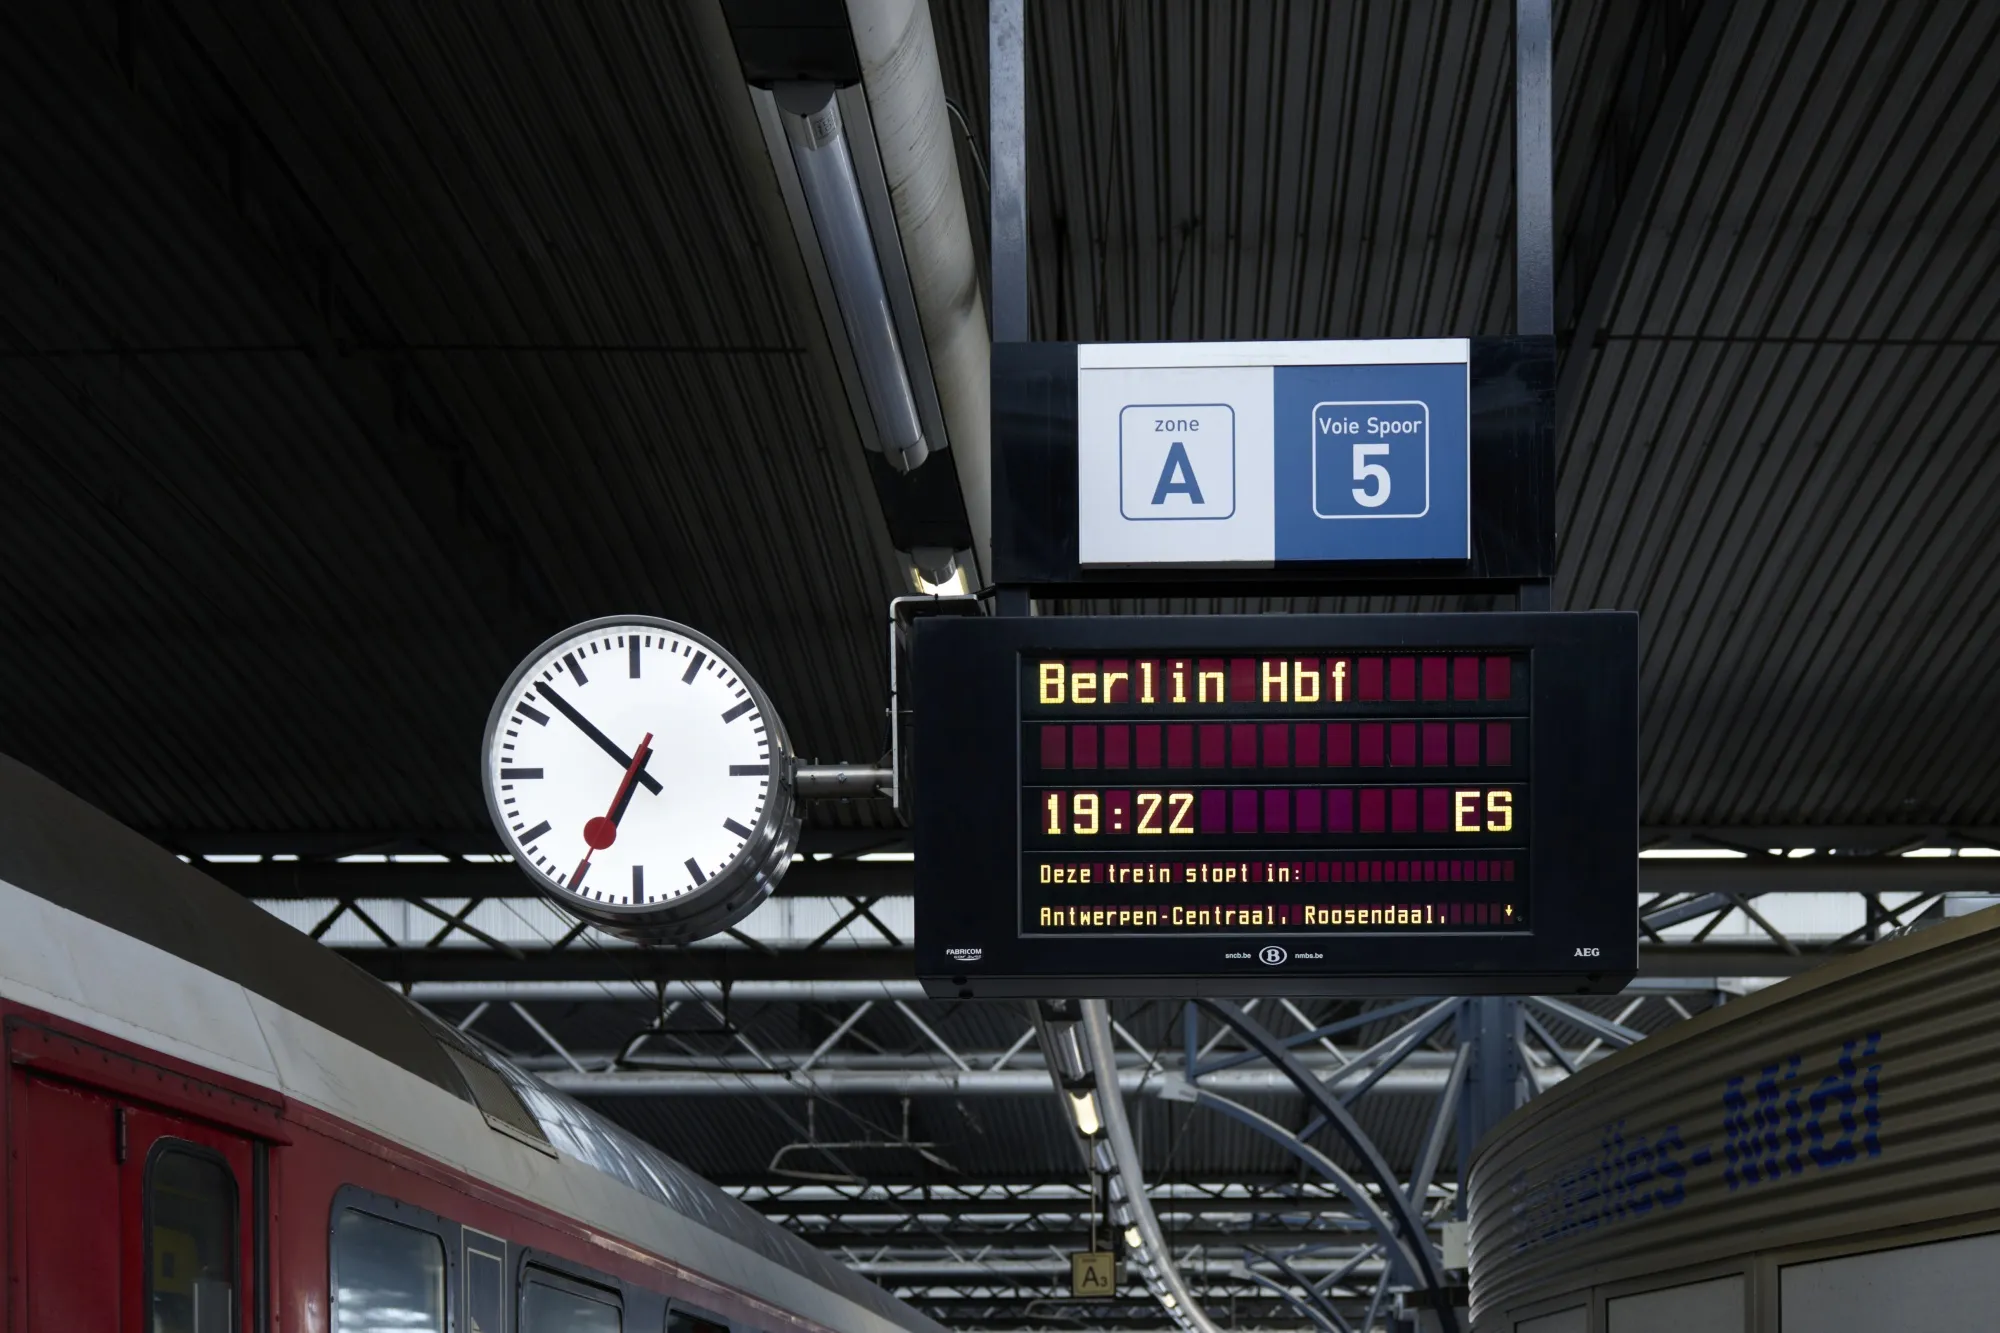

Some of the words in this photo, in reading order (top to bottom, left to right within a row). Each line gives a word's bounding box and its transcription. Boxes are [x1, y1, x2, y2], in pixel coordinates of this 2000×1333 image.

[1154, 418, 1200, 432] zone
[1319, 417, 1360, 435] Voie
[1366, 416, 1423, 438] Spoor
[1150, 441, 1206, 505] A
[1351, 443, 1391, 508] 5
[1039, 662, 1226, 705] Berlin
[1262, 661, 1347, 704] Hbf
[1047, 793, 1195, 836] 19:22
[1455, 790, 1513, 833] ES
[1040, 864, 1091, 884] Deze
[1108, 864, 1170, 884] trein
[1186, 863, 1248, 883] stopt
[1267, 863, 1300, 883] in:
[1040, 906, 1287, 927] Antwerpen-Centraal,
[1305, 904, 1446, 926] Roosendaal,
[1266, 948, 1280, 963] B
[1573, 947, 1600, 957] AEG
